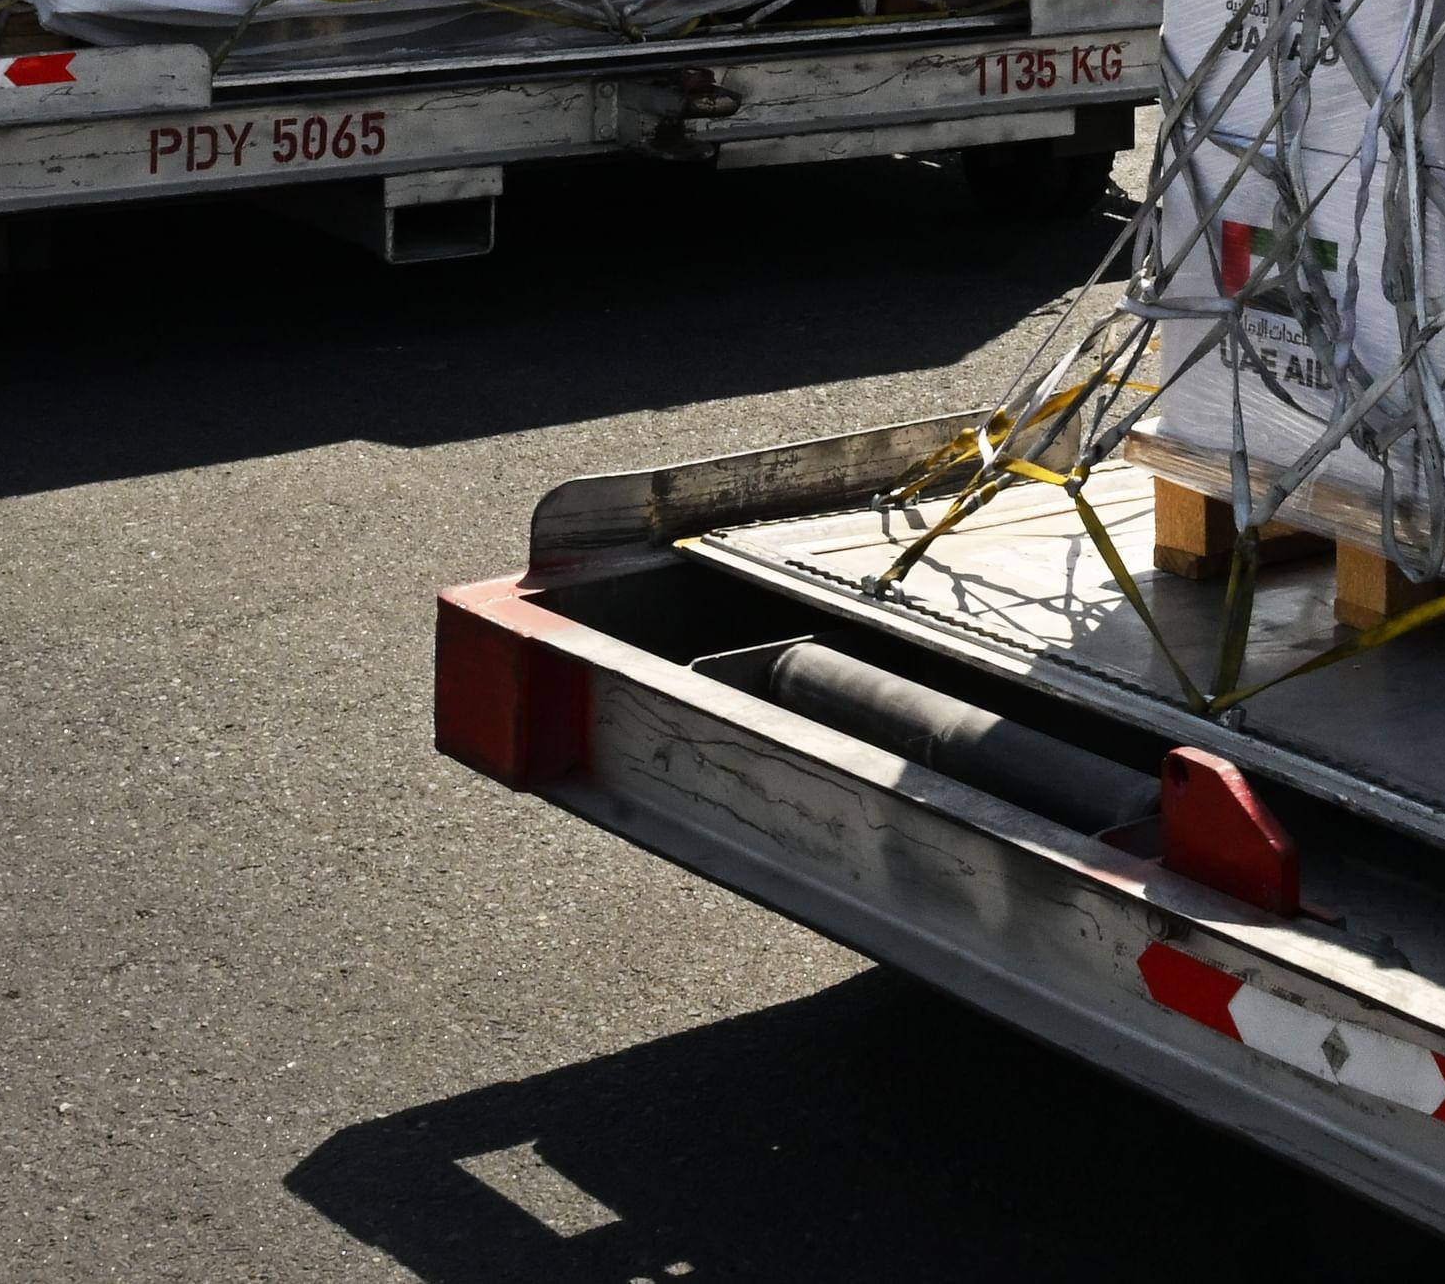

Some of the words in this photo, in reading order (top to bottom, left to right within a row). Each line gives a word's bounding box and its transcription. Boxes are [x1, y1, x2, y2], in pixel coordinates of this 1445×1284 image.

[976, 49, 1057, 96] 1135
[1072, 43, 1123, 85] KG
[150, 122, 253, 174] PDY
[272, 111, 386, 163] 5065
